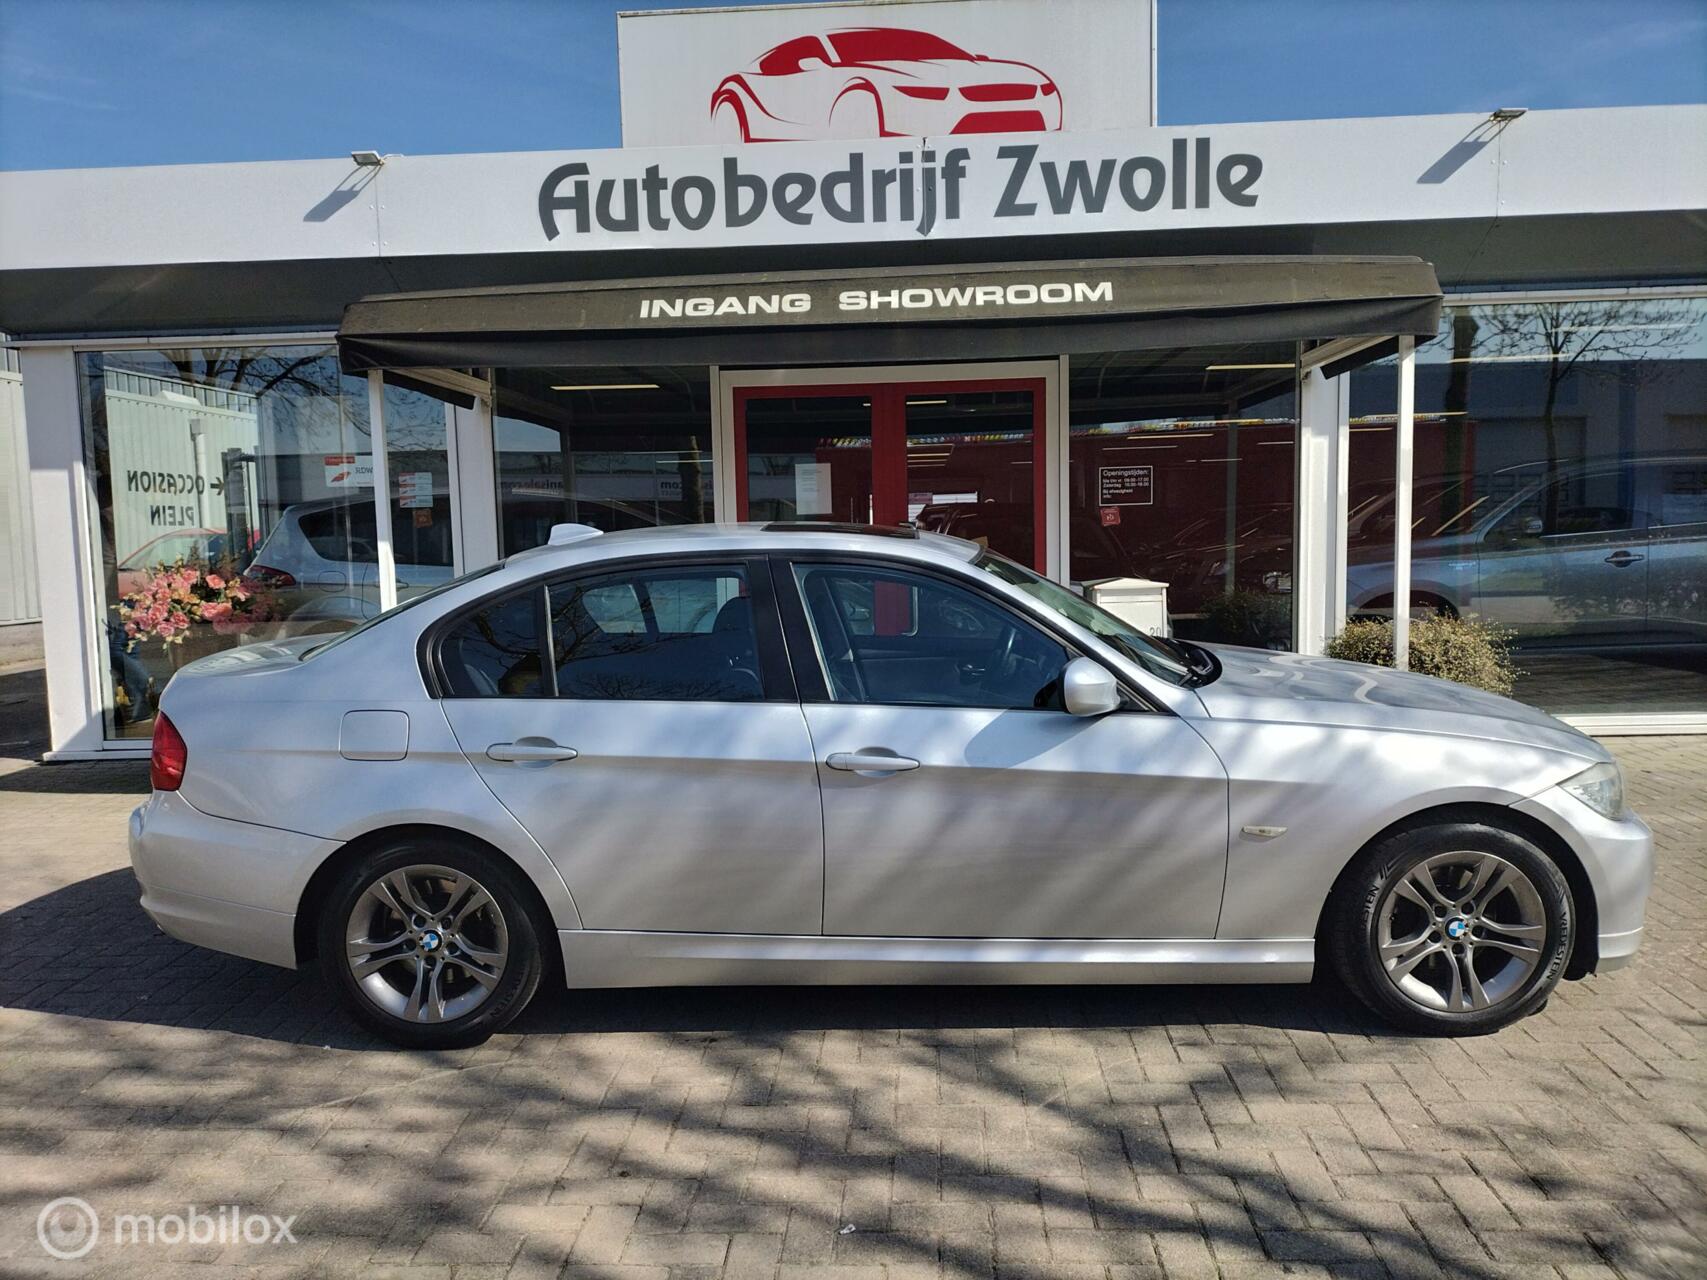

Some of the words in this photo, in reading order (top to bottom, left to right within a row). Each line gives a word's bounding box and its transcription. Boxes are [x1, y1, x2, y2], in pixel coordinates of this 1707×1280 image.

[538, 147, 971, 242] Autobedrijf
[993, 137, 1264, 218] Zwolle
[639, 292, 812, 318] INGANG
[838, 281, 1115, 312] SHOWROOM
